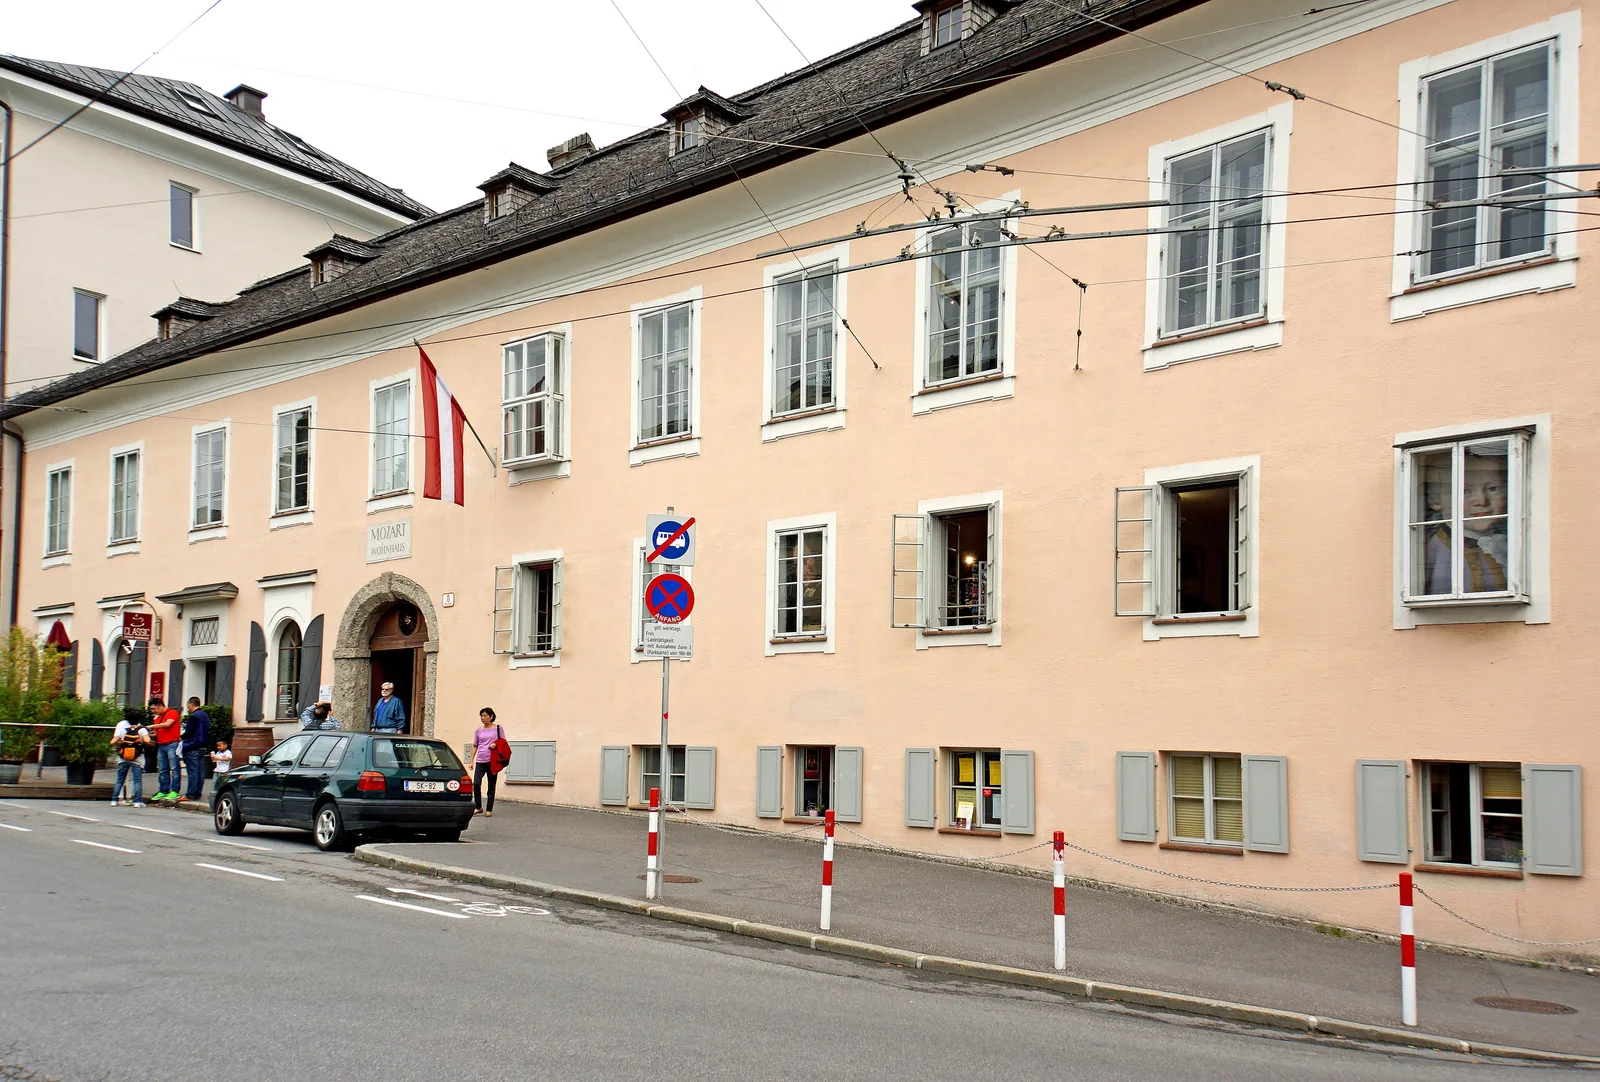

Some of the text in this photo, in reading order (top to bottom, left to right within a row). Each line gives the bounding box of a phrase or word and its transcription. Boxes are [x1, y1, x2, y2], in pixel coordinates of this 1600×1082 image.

[372, 522, 406, 541] MOZART
[371, 543, 406, 556] WOHNHAUS
[655, 613, 682, 622] ANFANG
[124, 627, 150, 636] CLASSIC
